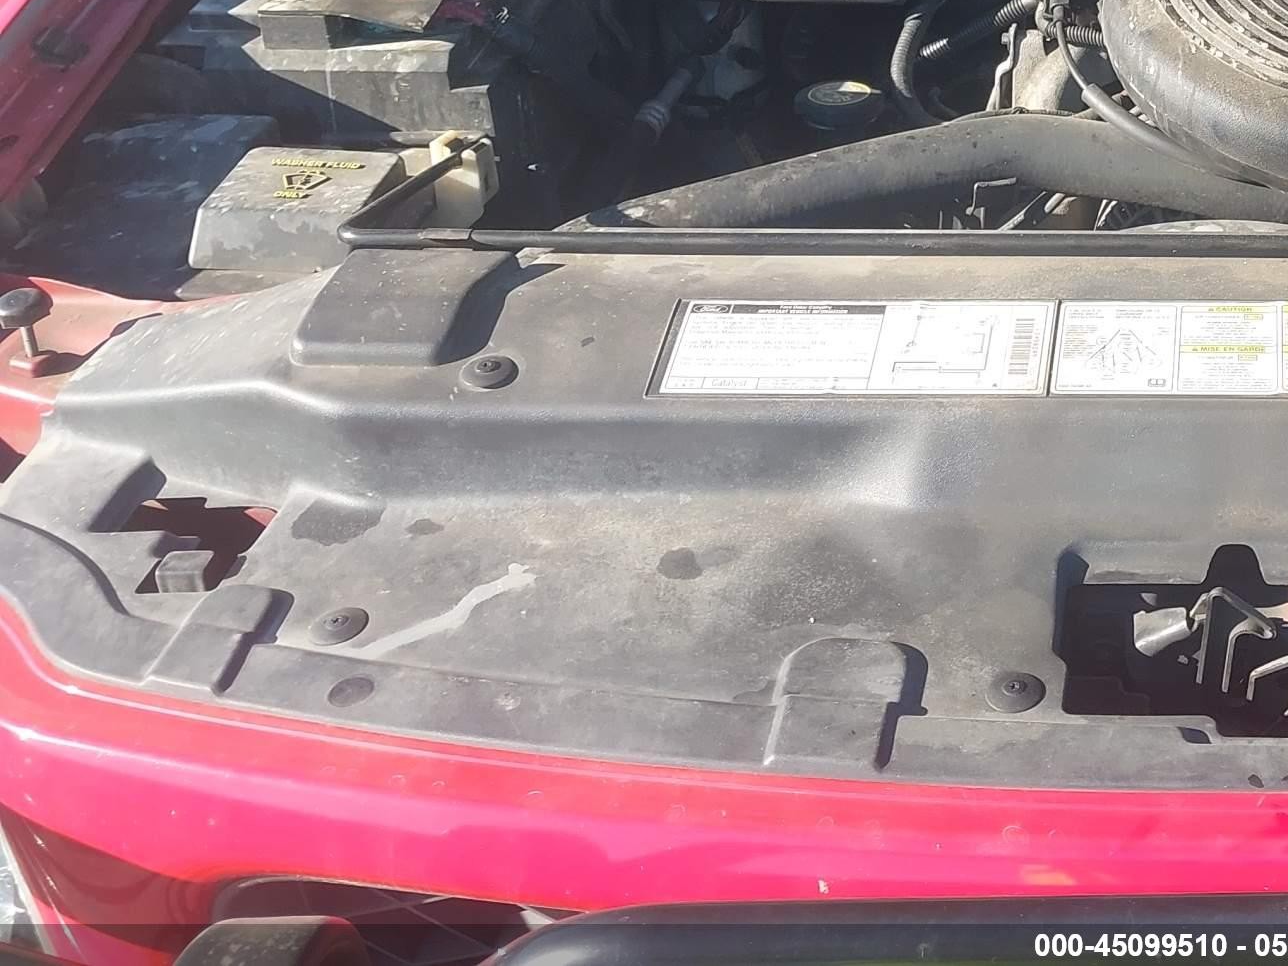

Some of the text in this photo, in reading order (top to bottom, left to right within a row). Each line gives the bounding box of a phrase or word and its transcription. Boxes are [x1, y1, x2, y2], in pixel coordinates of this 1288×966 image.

[271, 158, 362, 170] WASHER FLUID
[273, 190, 305, 199] ONLY
